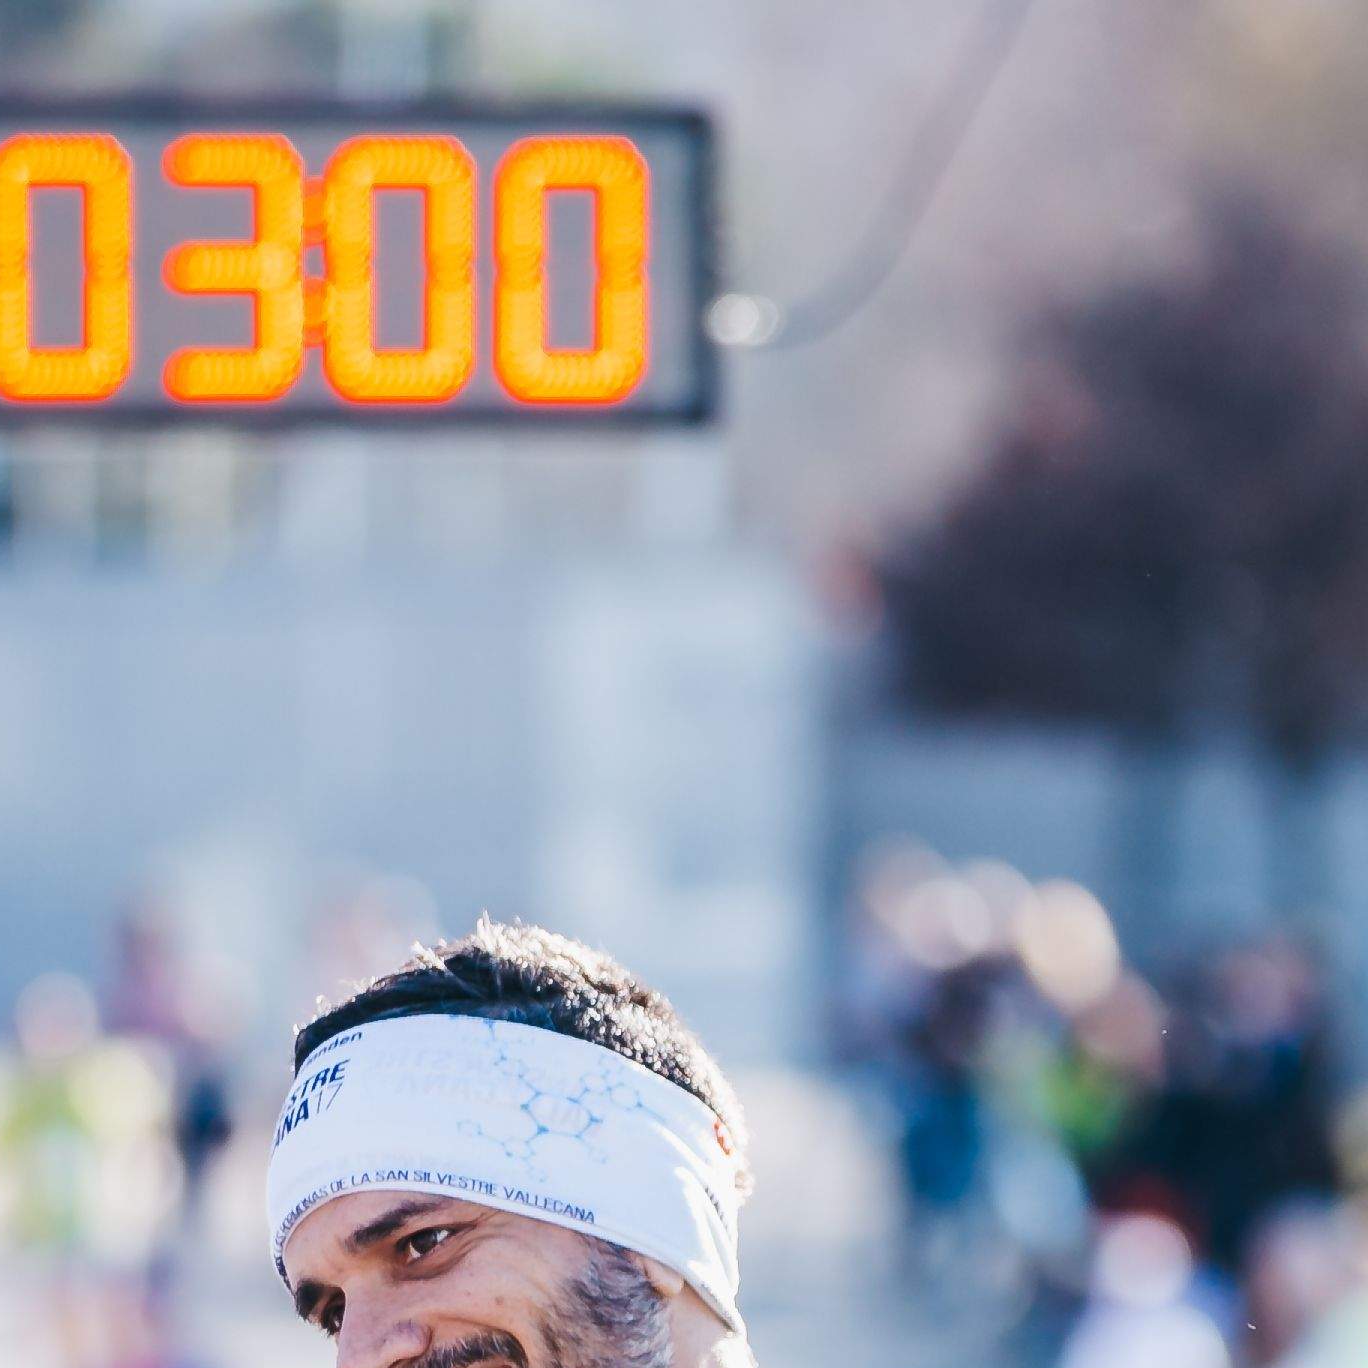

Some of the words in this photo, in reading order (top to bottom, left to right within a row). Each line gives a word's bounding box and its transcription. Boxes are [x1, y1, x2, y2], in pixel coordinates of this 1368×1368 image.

[351, 1172, 371, 1187] LA
[375, 1169, 409, 1183] SAN
[413, 1169, 496, 1198] SILVESTRE
[503, 1185, 595, 1225] VALLECANA
